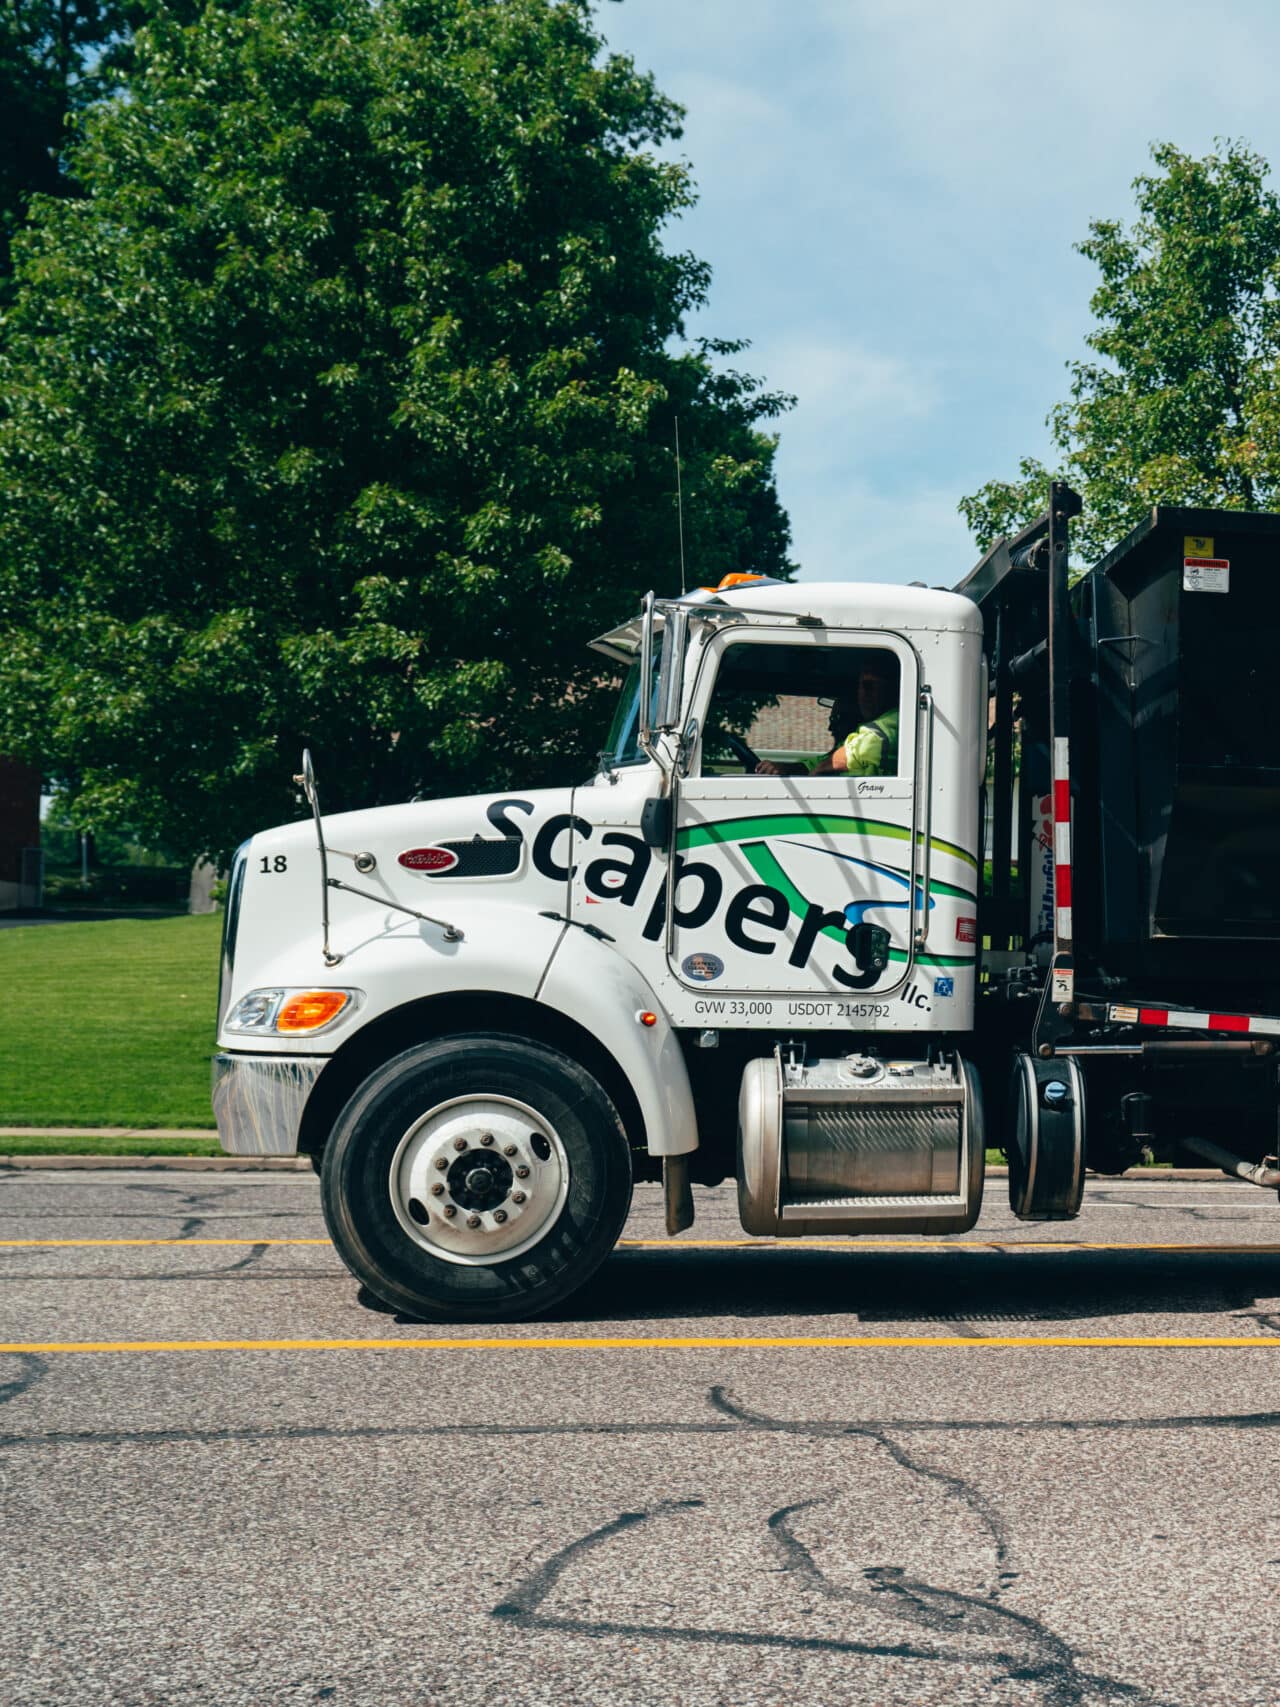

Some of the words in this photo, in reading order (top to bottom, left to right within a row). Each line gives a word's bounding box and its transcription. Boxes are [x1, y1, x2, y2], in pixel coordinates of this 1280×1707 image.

[259, 855, 288, 874] 18
[900, 982, 932, 1012] llc.
[694, 1001, 726, 1015] GVW
[729, 1002, 773, 1017] 33,000
[788, 1003, 833, 1017] USDOT
[836, 1004, 890, 1018] 2145792
